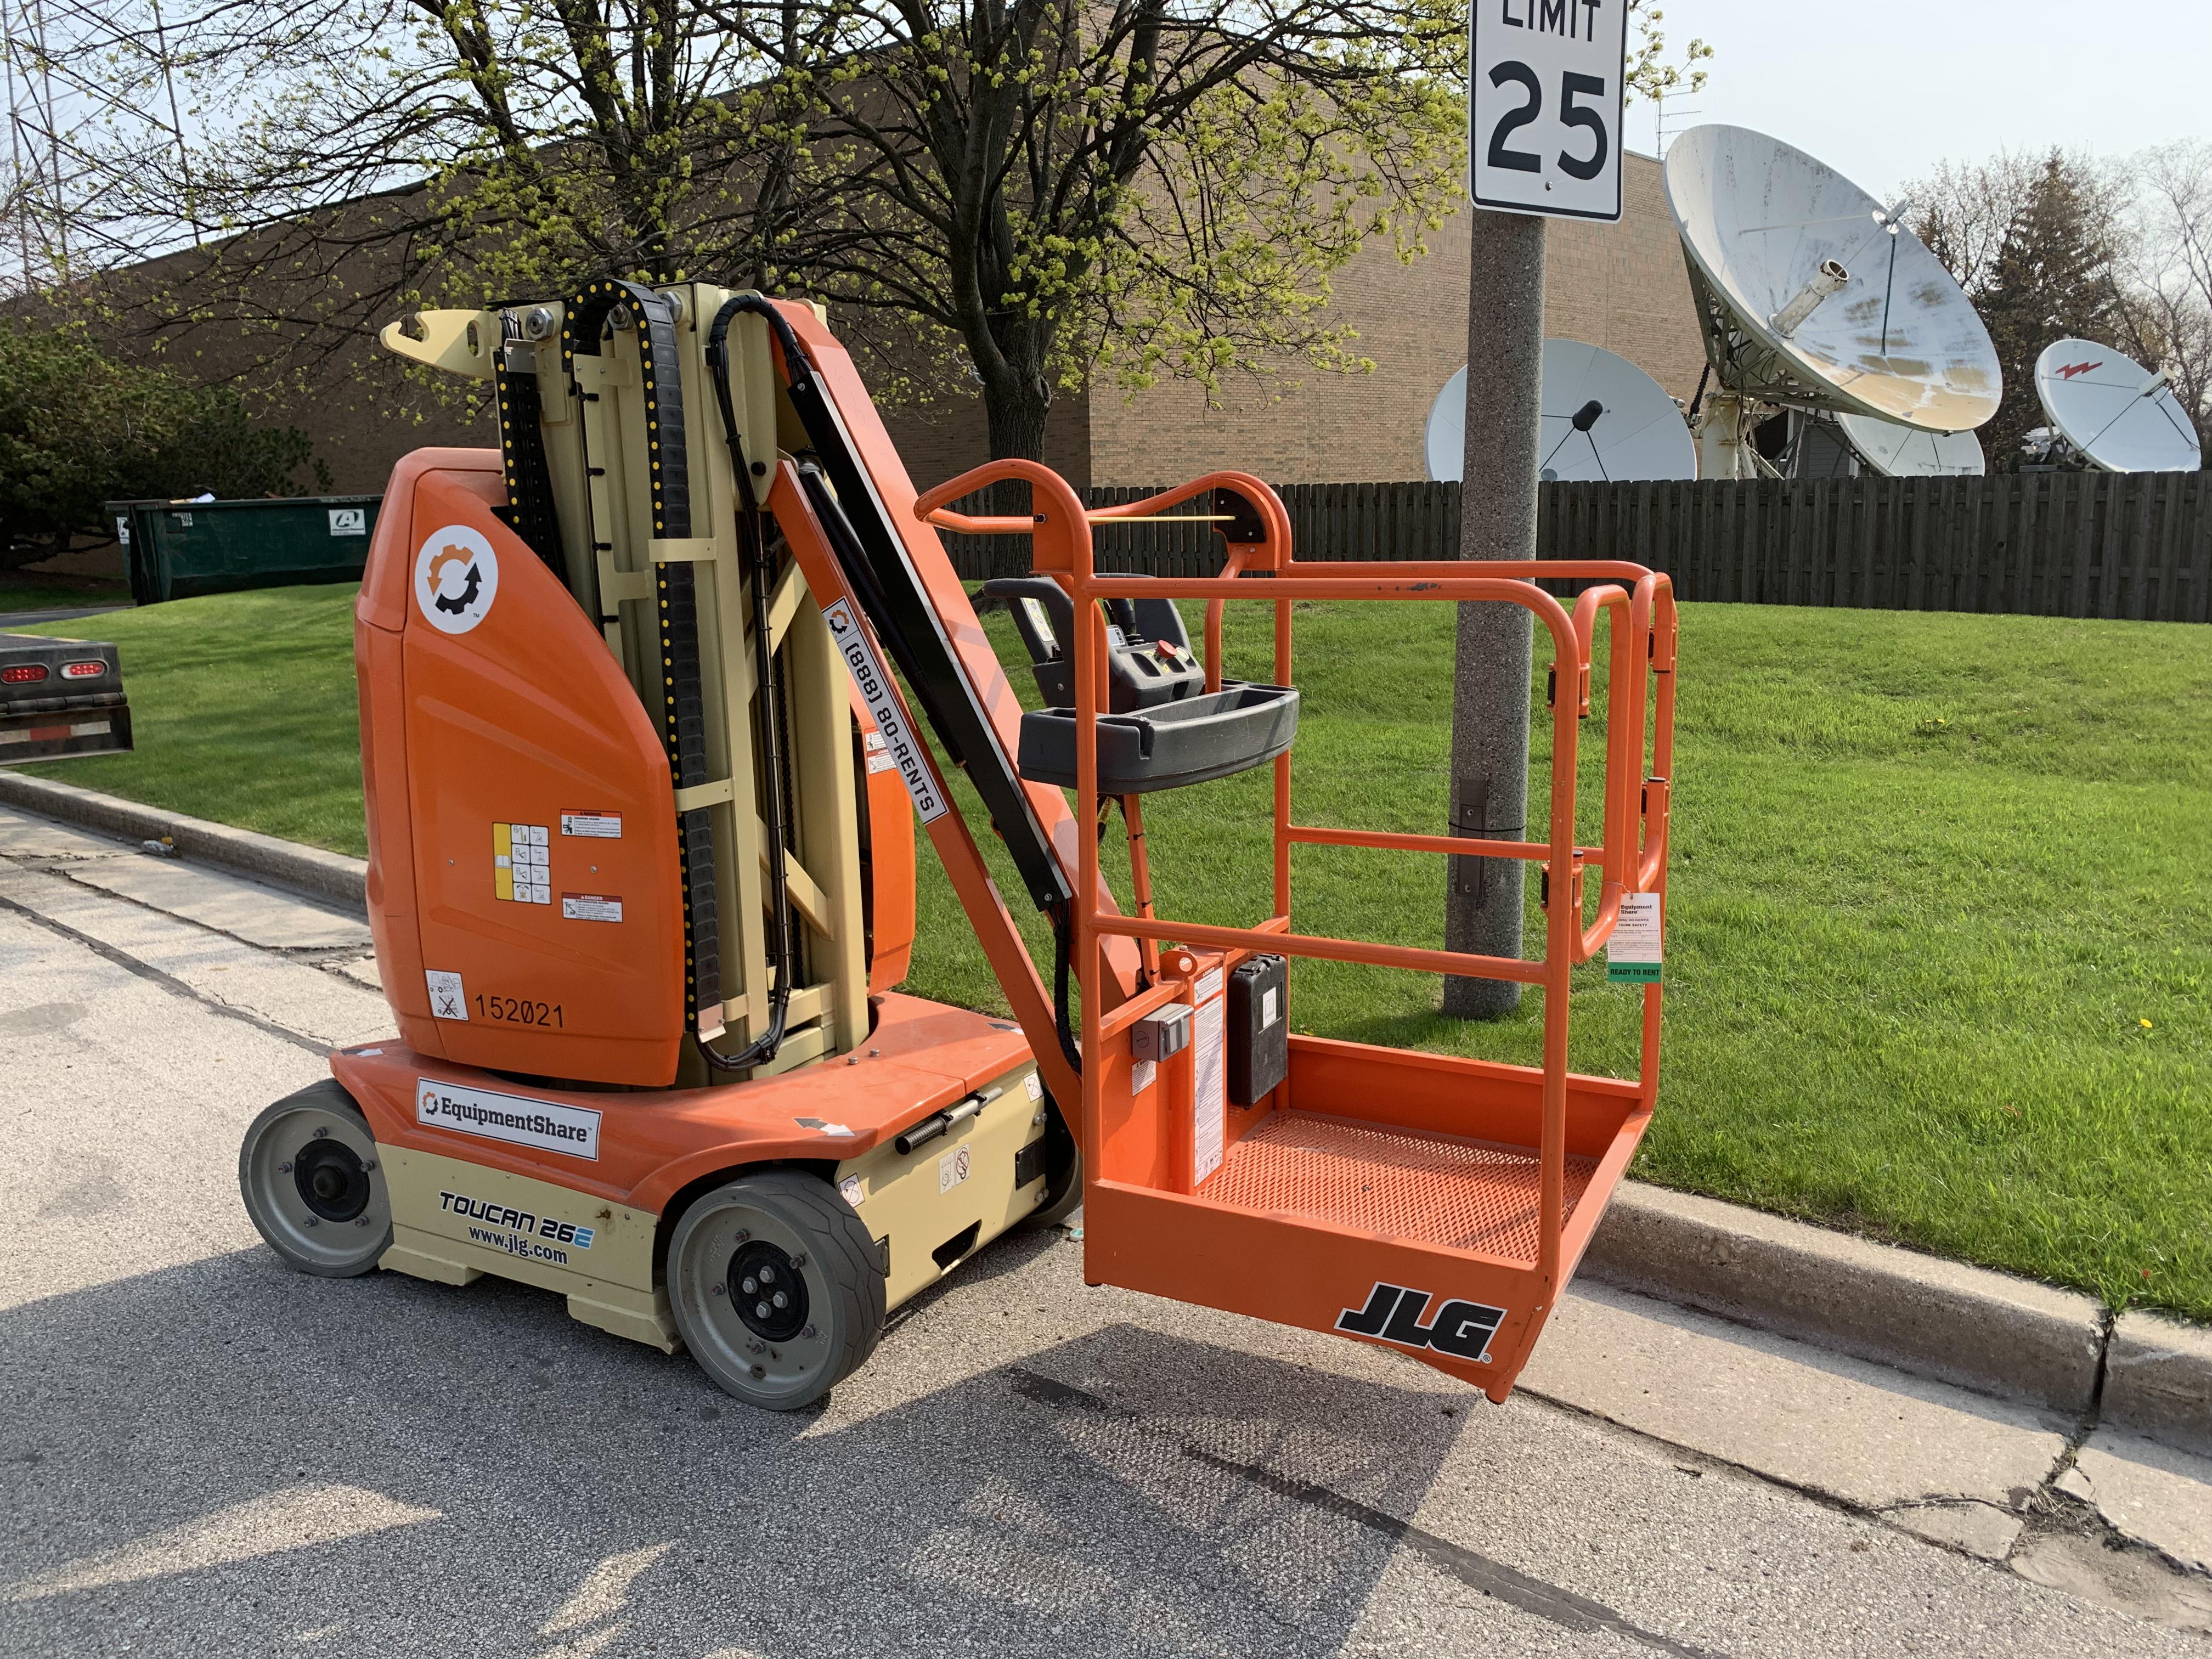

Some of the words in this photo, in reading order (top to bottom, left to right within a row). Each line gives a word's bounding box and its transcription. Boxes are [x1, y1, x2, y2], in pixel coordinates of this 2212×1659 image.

[1503, 0, 1600, 42] LIMIT
[1487, 60, 1608, 180] 25
[845, 642, 883, 703] (888)
[877, 707, 934, 812] 80-RENTS
[476, 994, 563, 1028] 152021
[441, 1097, 588, 1143] EquipmentShare
[439, 1190, 537, 1233] TOUCAN
[539, 1217, 595, 1249] 26E
[468, 1226, 568, 1265] www.jlg.com
[1335, 1282, 1507, 1361] JLG
